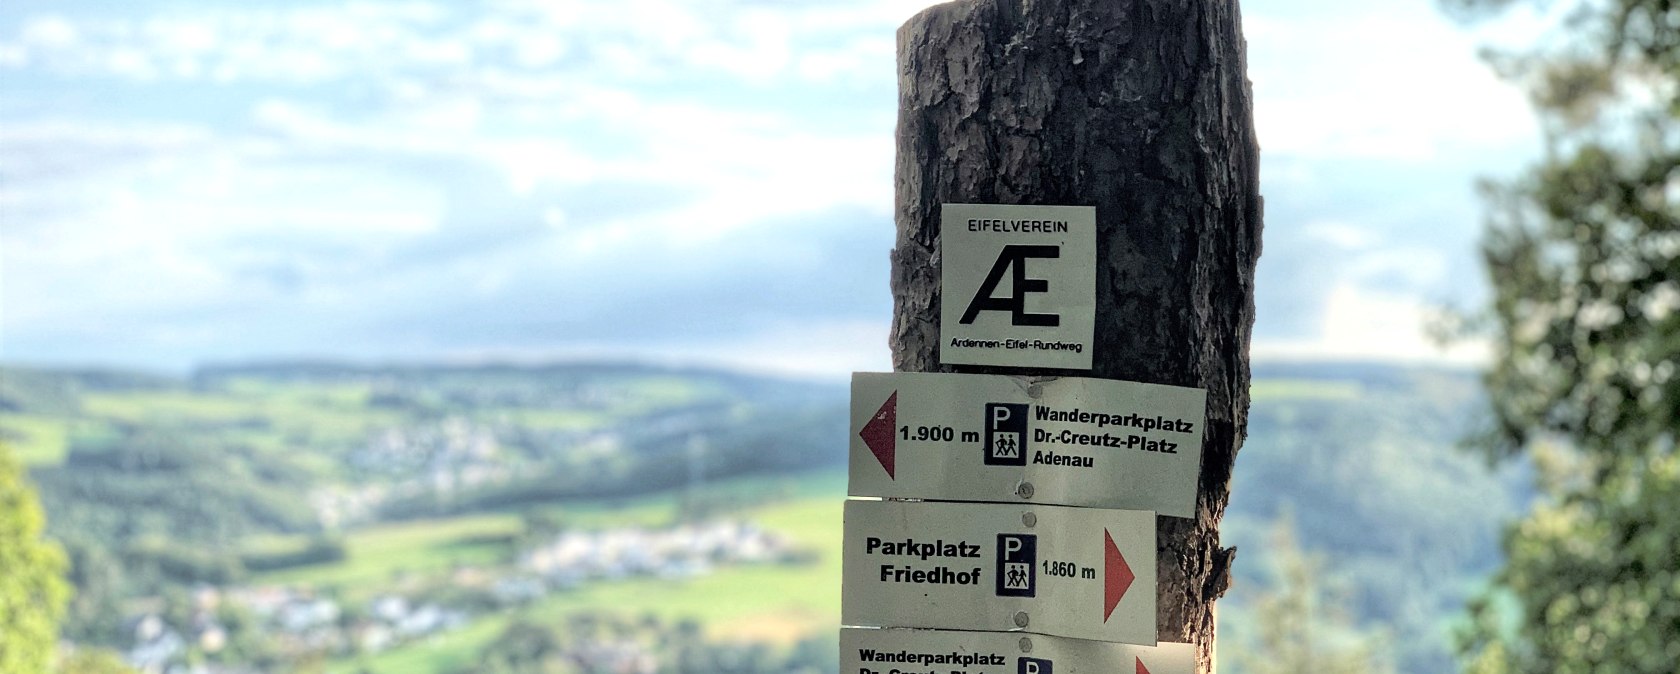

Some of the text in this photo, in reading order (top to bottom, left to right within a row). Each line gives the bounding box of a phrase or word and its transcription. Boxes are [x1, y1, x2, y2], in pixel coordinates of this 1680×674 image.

[968, 219, 1068, 233] EIFELVEREIN
[950, 338, 1083, 353] Ardennen-Eifel-Rundweg
[993, 406, 1010, 430] P
[1035, 405, 1194, 433] Wanderparkplatz
[900, 426, 980, 443] 1.900 m
[1034, 428, 1178, 454] Dr.-Creutz-Platz
[1033, 451, 1094, 468] Adenau
[866, 537, 981, 559] Parkplatz
[1004, 537, 1022, 561] P
[880, 564, 982, 586] Friedhof
[1042, 559, 1096, 580] 1.860 m
[859, 649, 1006, 666] Wanderparkplatz
